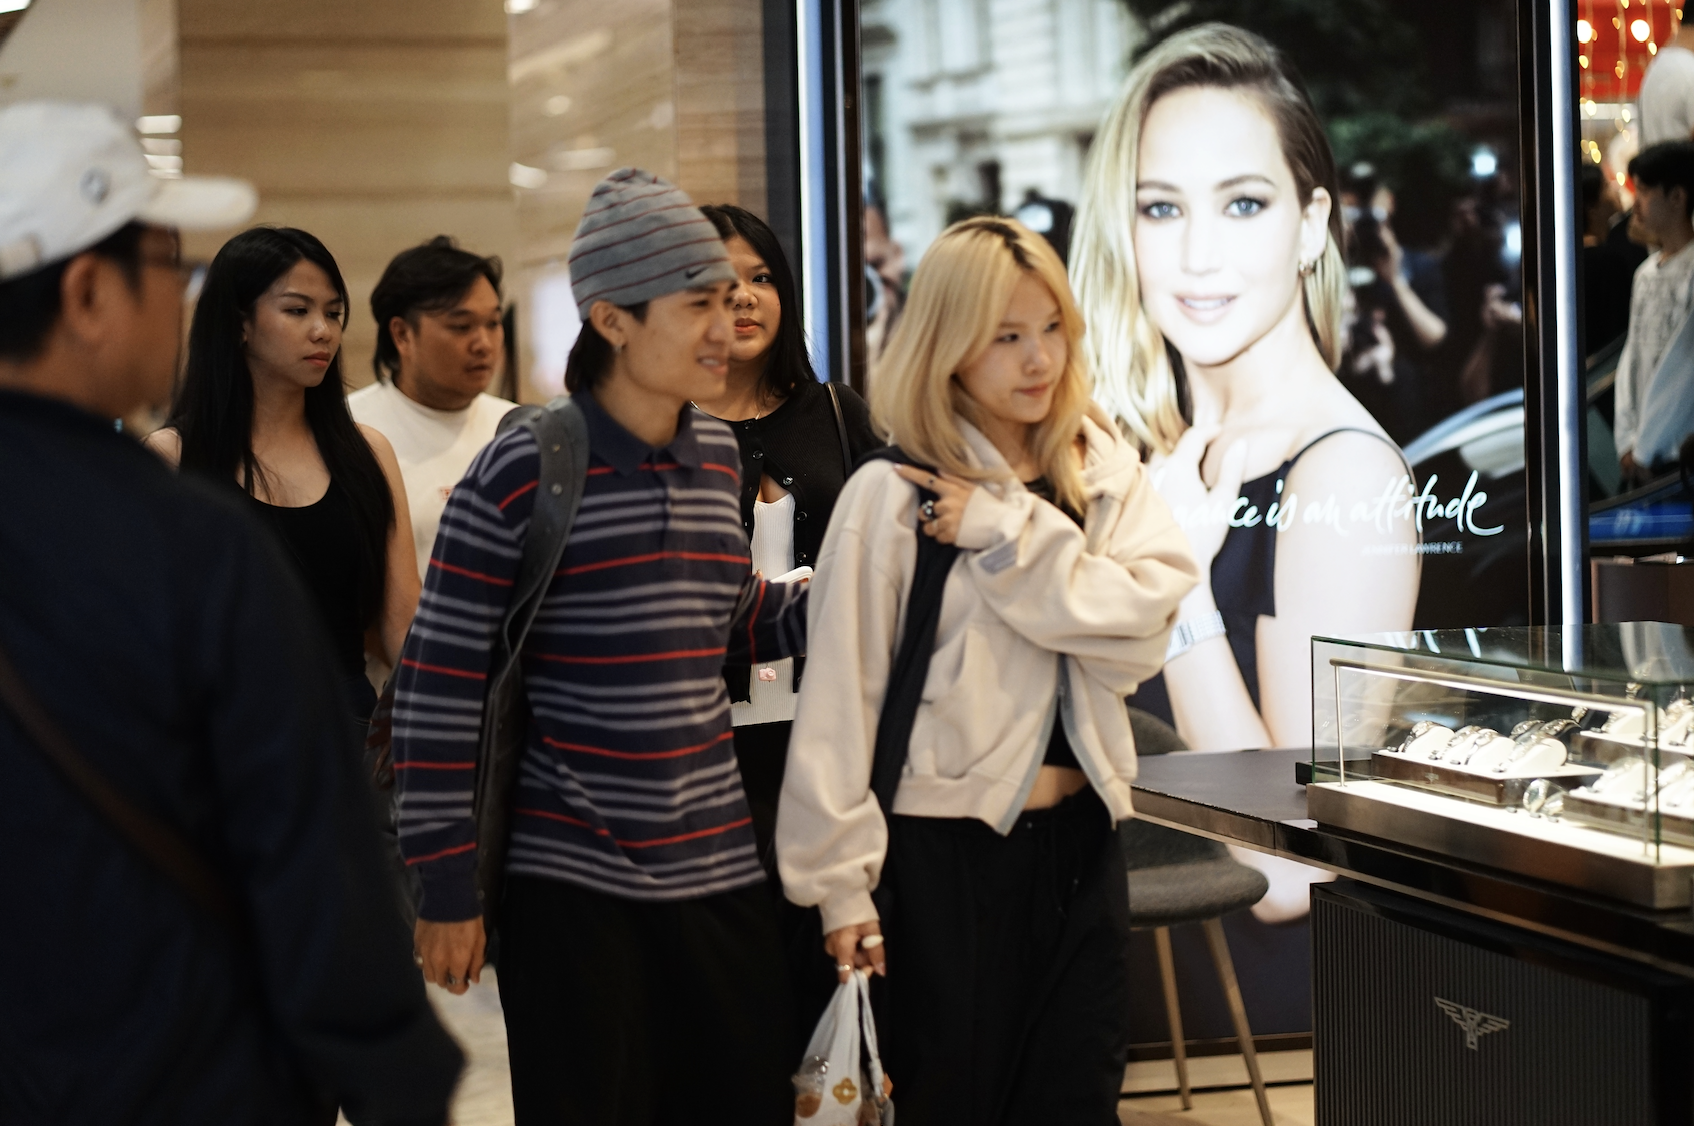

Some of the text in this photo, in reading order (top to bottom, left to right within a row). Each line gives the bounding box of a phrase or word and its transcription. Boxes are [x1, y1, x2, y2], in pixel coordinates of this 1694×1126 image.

[1266, 479, 1297, 532] is
[1302, 492, 1350, 538] an
[1349, 470, 1504, 535] attitude
